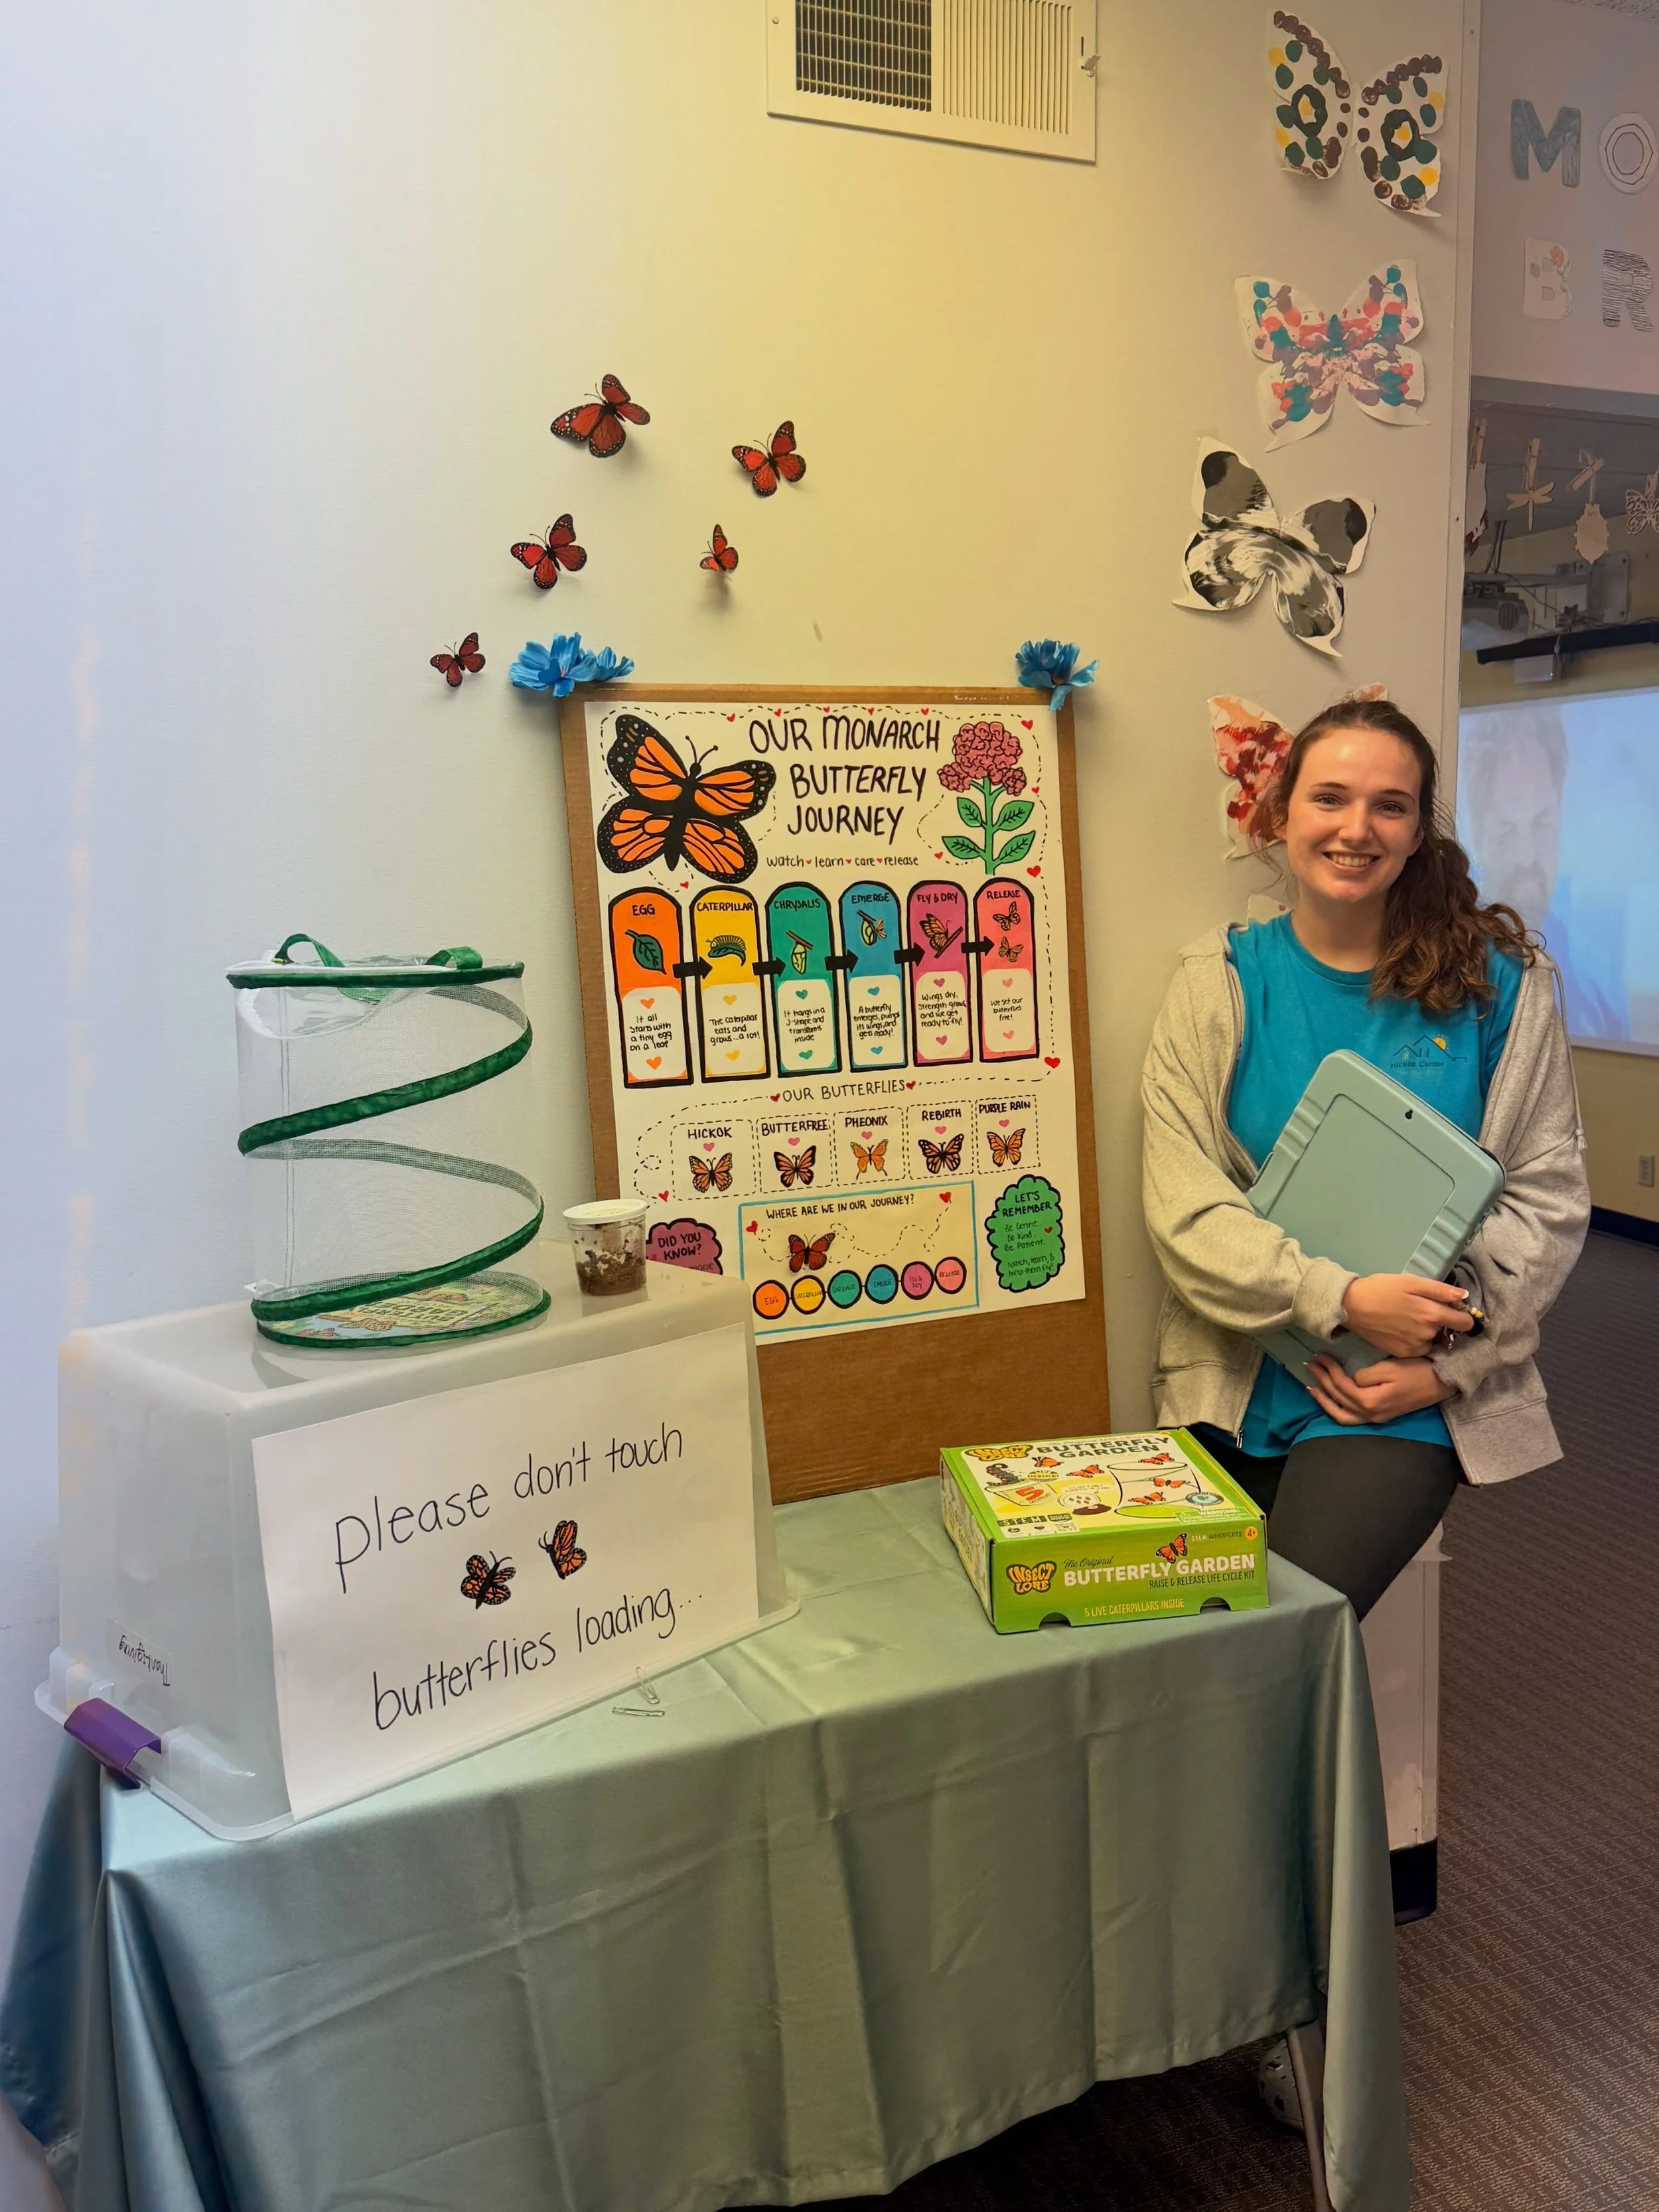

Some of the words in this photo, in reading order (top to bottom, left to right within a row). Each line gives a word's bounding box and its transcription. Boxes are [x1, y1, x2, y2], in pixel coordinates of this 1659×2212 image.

[749, 718, 813, 754] OUR
[823, 715, 940, 753] MONARCH
[790, 763, 926, 802] BUTTERFLY
[787, 804, 904, 846] JOURNEY
[766, 855, 804, 867] watch
[815, 855, 844, 867] learn
[855, 857, 875, 867] care
[884, 855, 918, 866] release
[851, 893, 890, 904] EMERGE
[917, 894, 930, 904] FLY
[934, 894, 940, 903] &
[941, 892, 958, 904] DRY
[987, 890, 1021, 900] RELEASE
[632, 904, 656, 917] EGG
[696, 901, 754, 912] CATERPILLAR
[774, 898, 822, 911] CHRYSALIS
[793, 1009, 812, 1018] hangs
[865, 1003, 892, 1013] butterfly
[947, 1010, 958, 1019] get
[653, 1023, 672, 1031] with
[732, 1024, 747, 1033] and
[922, 1019, 941, 1027] ready
[639, 1034, 655, 1045] tiny
[658, 1031, 672, 1041] egg
[795, 1034, 815, 1043] inside
[783, 1087, 814, 1102] OUR
[822, 1079, 905, 1100] BUTTERFLIES
[979, 1103, 1007, 1114] PURPLE
[1010, 1100, 1031, 1110] RAIN
[845, 1115, 888, 1128] PHEONIX
[922, 1108, 962, 1122] REBIRTH
[688, 1127, 732, 1140] HICKOK
[761, 1119, 829, 1137] BUTTERFREE
[1015, 1191, 1040, 1203] LET'S
[766, 1207, 798, 1219] WHERE
[801, 1205, 819, 1216] ARE
[822, 1204, 834, 1213] WE
[838, 1203, 847, 1212] IN
[849, 1200, 867, 1211] OUR
[870, 1193, 914, 1207] JOURNEY?
[1002, 1201, 1052, 1217] REMEMBER
[658, 1236, 677, 1248] DID
[680, 1232, 701, 1244] YOU
[664, 1244, 702, 1260] KNOW?
[1037, 1438, 1169, 1453] BUTTERFLY
[1059, 1445, 1160, 1457] GARDEN
[1016, 1487, 1044, 1501] 5
[335, 1483, 490, 1594] please
[514, 1441, 590, 1499] don't
[605, 1422, 683, 1472] touch
[1003, 1515, 1041, 1526] STEM
[1080, 1556, 1114, 1568] Original
[1009, 1563, 1054, 1583] INSECT
[1064, 1562, 1171, 1586] BUTTERFLY
[1177, 1554, 1255, 1575] GARDEN
[1149, 1579, 1168, 1589] RAISE
[1177, 1575, 1206, 1585] RELEASE
[1207, 1574, 1221, 1582] LIFE
[1222, 1572, 1241, 1581] CYCLE
[1244, 1570, 1254, 1580] KIT
[1016, 1580, 1049, 1593] LORE
[1092, 1606, 1106, 1617] LIVE
[1110, 1600, 1159, 1615] CATERPILLARS
[1161, 1598, 1185, 1609] INSIDE
[119, 1635, 171, 1686] Thanksgiving
[373, 1631, 556, 1730] butterflies
